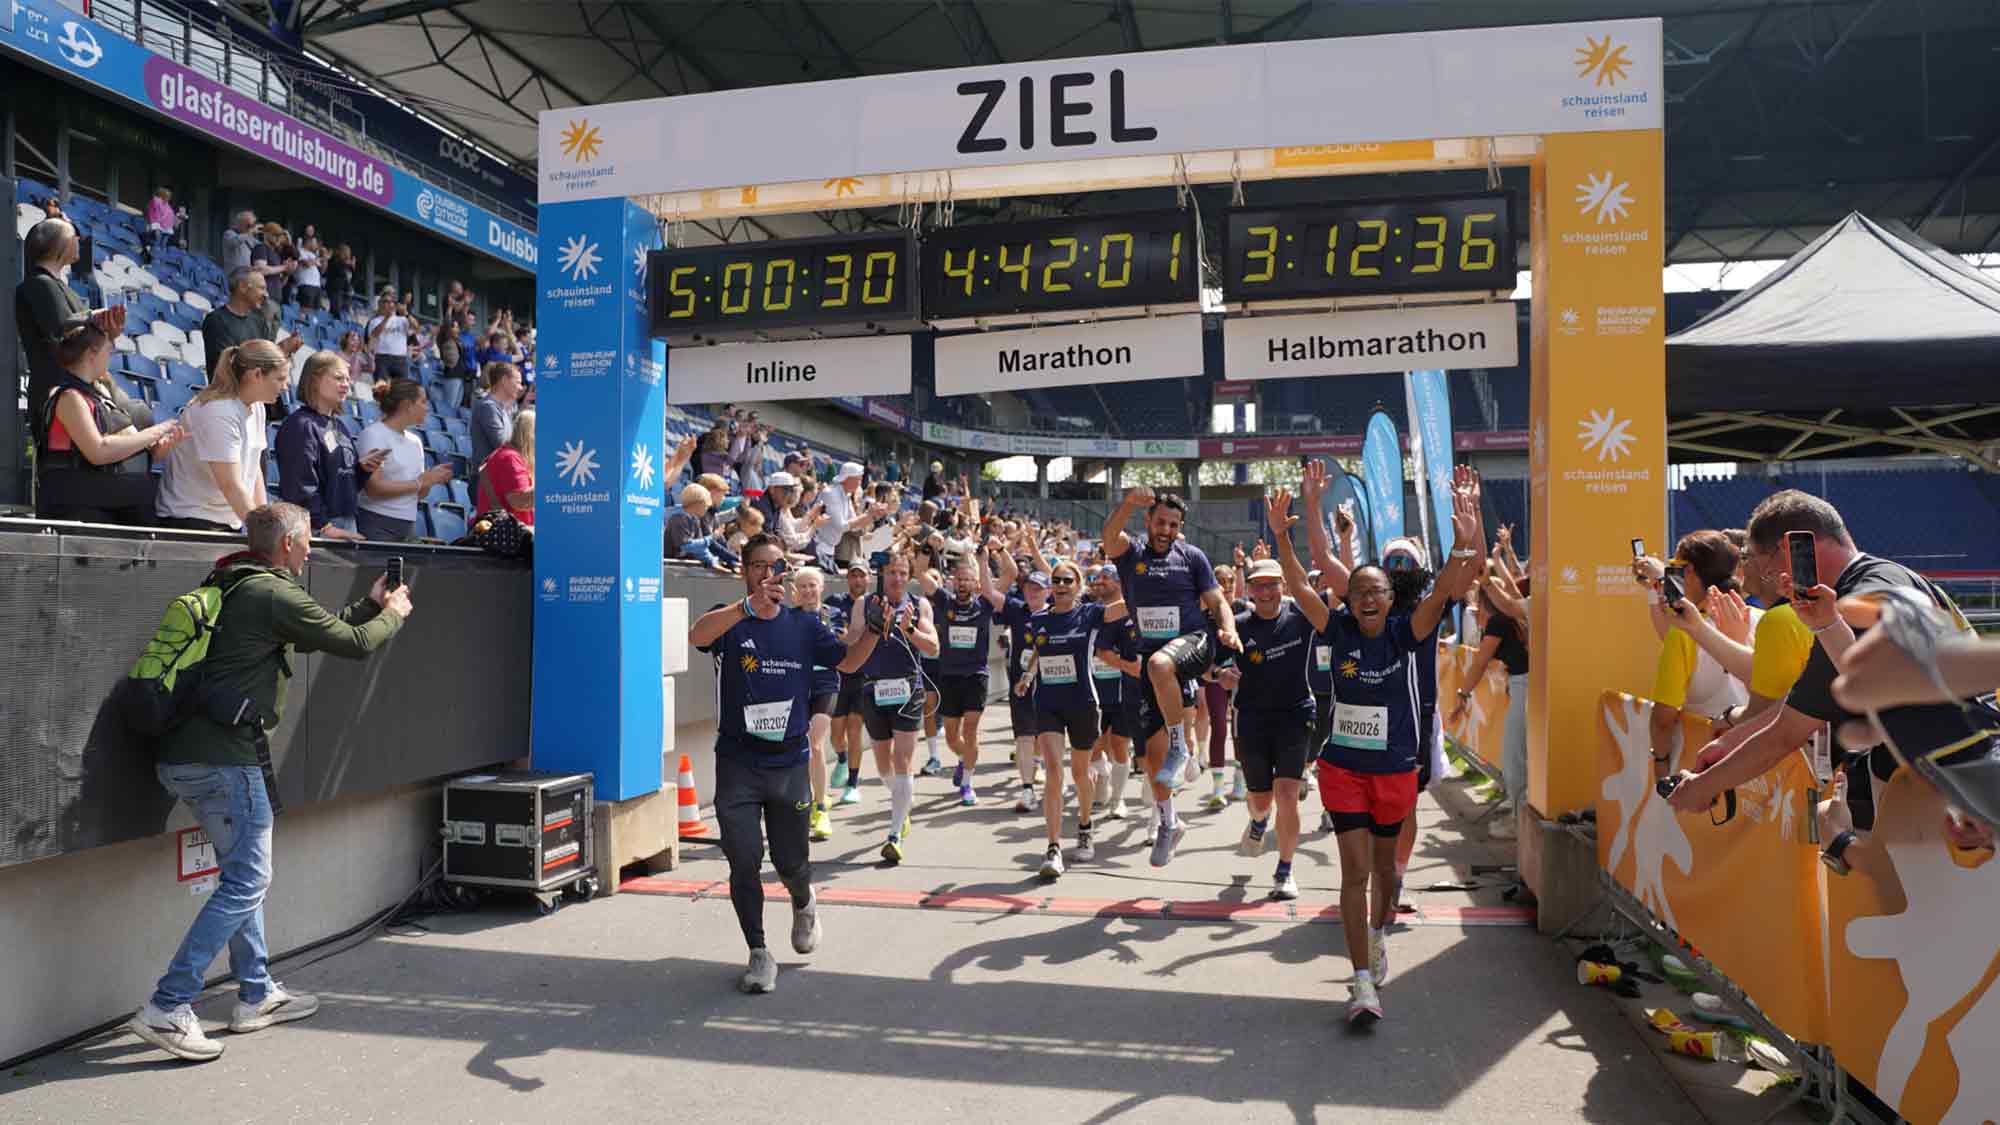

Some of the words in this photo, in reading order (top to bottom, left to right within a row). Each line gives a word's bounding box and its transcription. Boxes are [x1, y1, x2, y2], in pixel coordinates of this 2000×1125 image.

[1561, 92, 1648, 107] schauinsland
[956, 69, 1158, 153] ZIEL
[1584, 106, 1626, 118] reisen
[160, 73, 384, 195] glasfaserduisburg.de
[549, 165, 616, 181] schauinsland
[566, 180, 598, 191] reisen
[1561, 229, 1649, 242] schauinsland
[1243, 213, 1496, 283] 3:12:36
[1585, 242, 1627, 255] reisen
[944, 232, 1181, 296] 4:42:01
[547, 284, 613, 299] schauinsland
[669, 251, 896, 318] 5:00:30
[564, 297, 595, 308] reisen
[1268, 329, 1486, 362] Halbmarathon
[999, 344, 1131, 373] Marathon
[747, 361, 816, 383] Inline
[1564, 468, 1649, 481] schauinsland
[1586, 480, 1628, 494] reisen
[545, 492, 610, 504] schauinsland
[562, 503, 593, 513] reisen
[1340, 720, 1380, 736] WR2026
